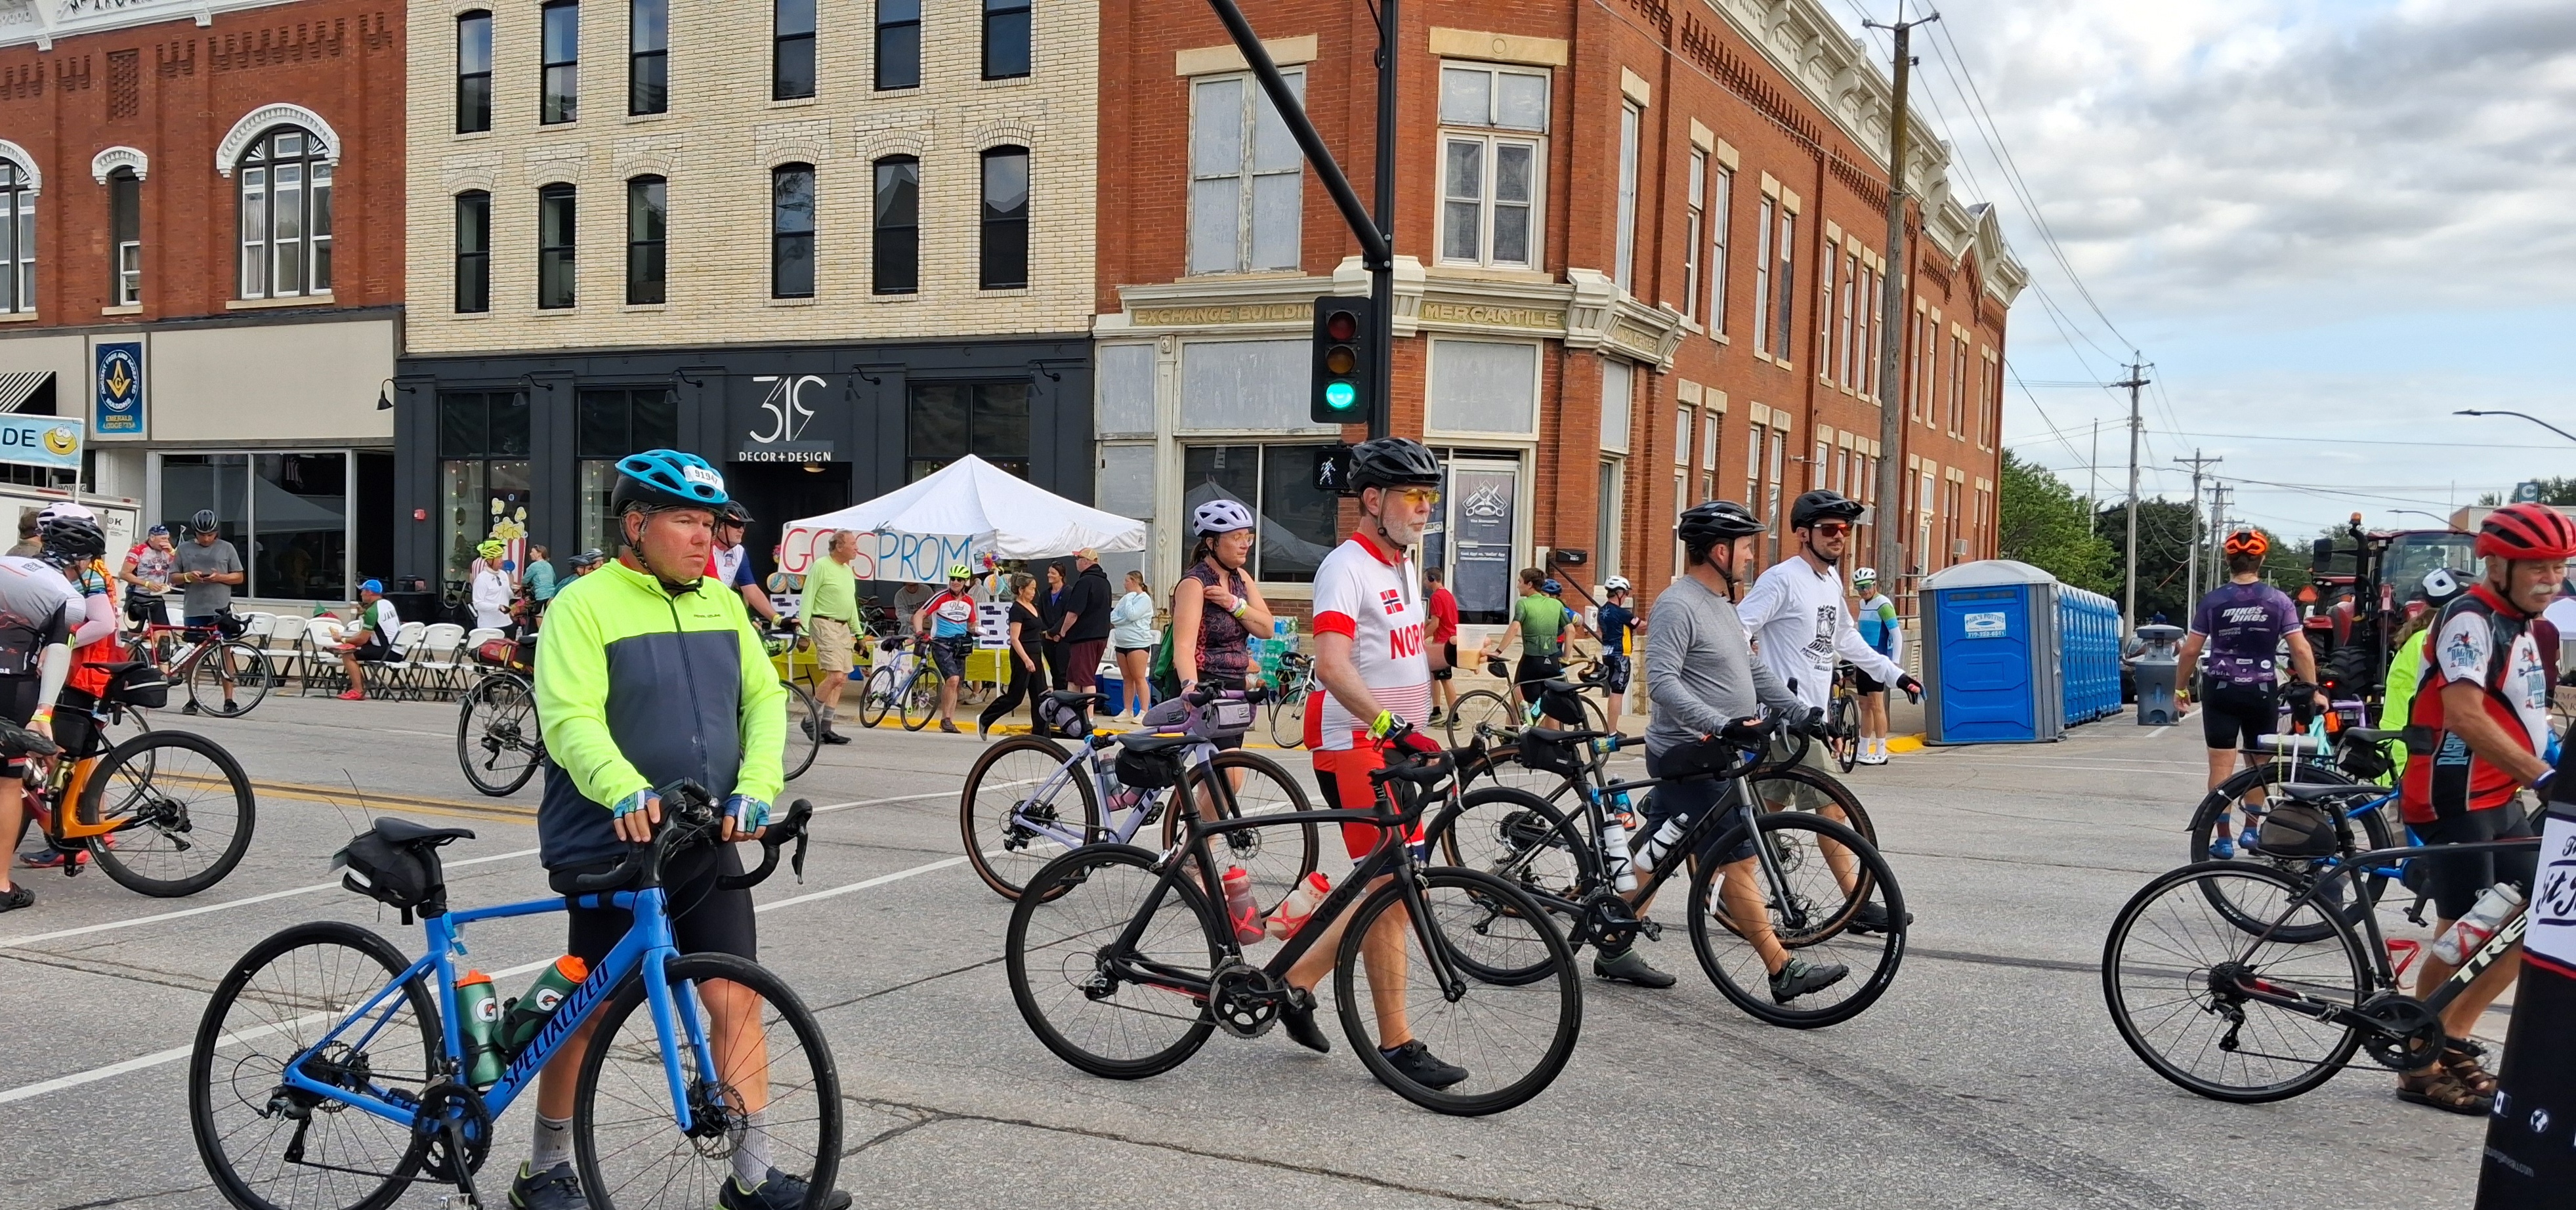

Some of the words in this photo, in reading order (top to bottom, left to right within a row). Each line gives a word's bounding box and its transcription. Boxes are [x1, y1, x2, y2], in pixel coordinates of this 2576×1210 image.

[1135, 308, 1232, 323] EXCHANGE
[1238, 303, 1313, 320] BUILDIN
[1424, 304, 1558, 326] MERCANTILE
[750, 375, 827, 444] 319
[3, 428, 36, 447] DE
[2522, 485, 2535, 498] C
[879, 532, 970, 583] PROM
[2450, 908, 2529, 983] TRE
[503, 961, 609, 1094] SPECIALIZED
